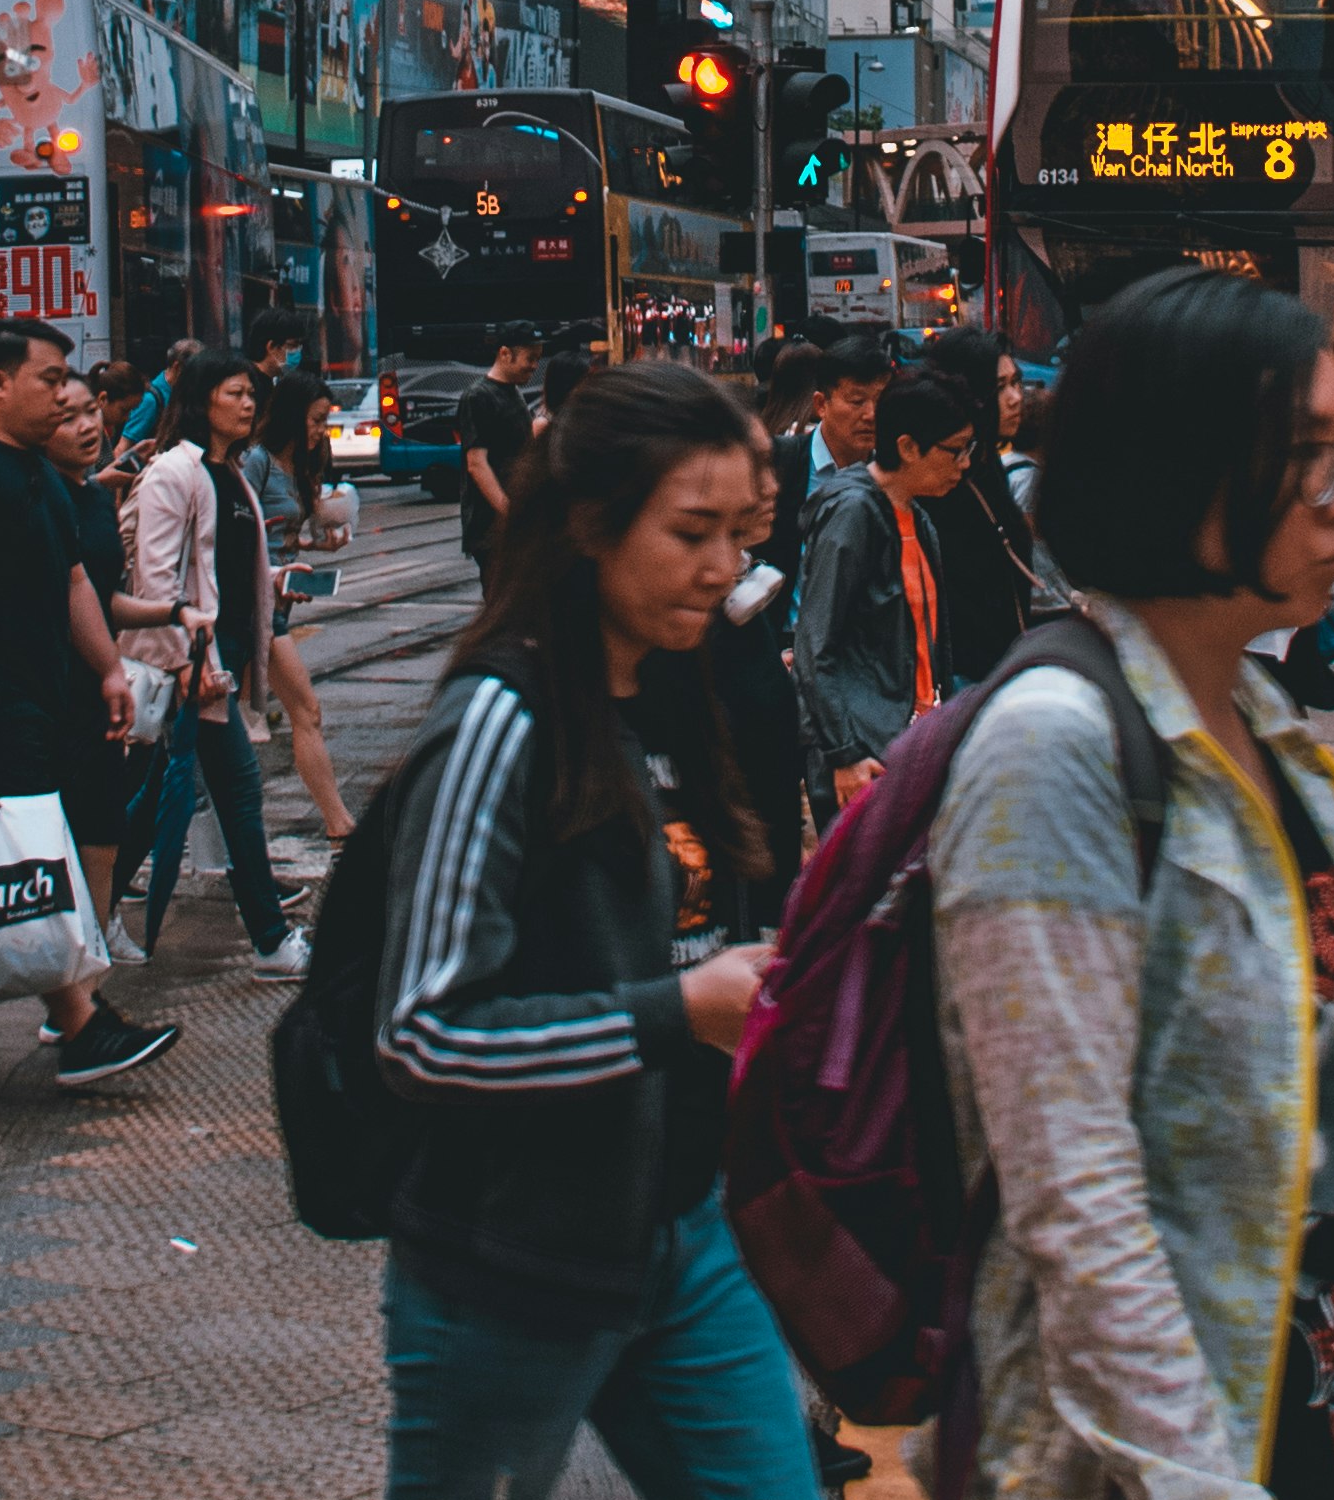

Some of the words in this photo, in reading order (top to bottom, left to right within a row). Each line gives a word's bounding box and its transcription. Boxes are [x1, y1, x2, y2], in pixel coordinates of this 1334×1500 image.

[1096, 123, 1226, 156] 灣仔北
[1231, 122, 1283, 137] Express
[1090, 155, 1126, 177] Wan
[1130, 154, 1172, 177] Chai
[1176, 154, 1234, 177] North
[1264, 138, 1295, 180] 8
[1038, 168, 1079, 184] 6134
[476, 191, 501, 216] 5B
